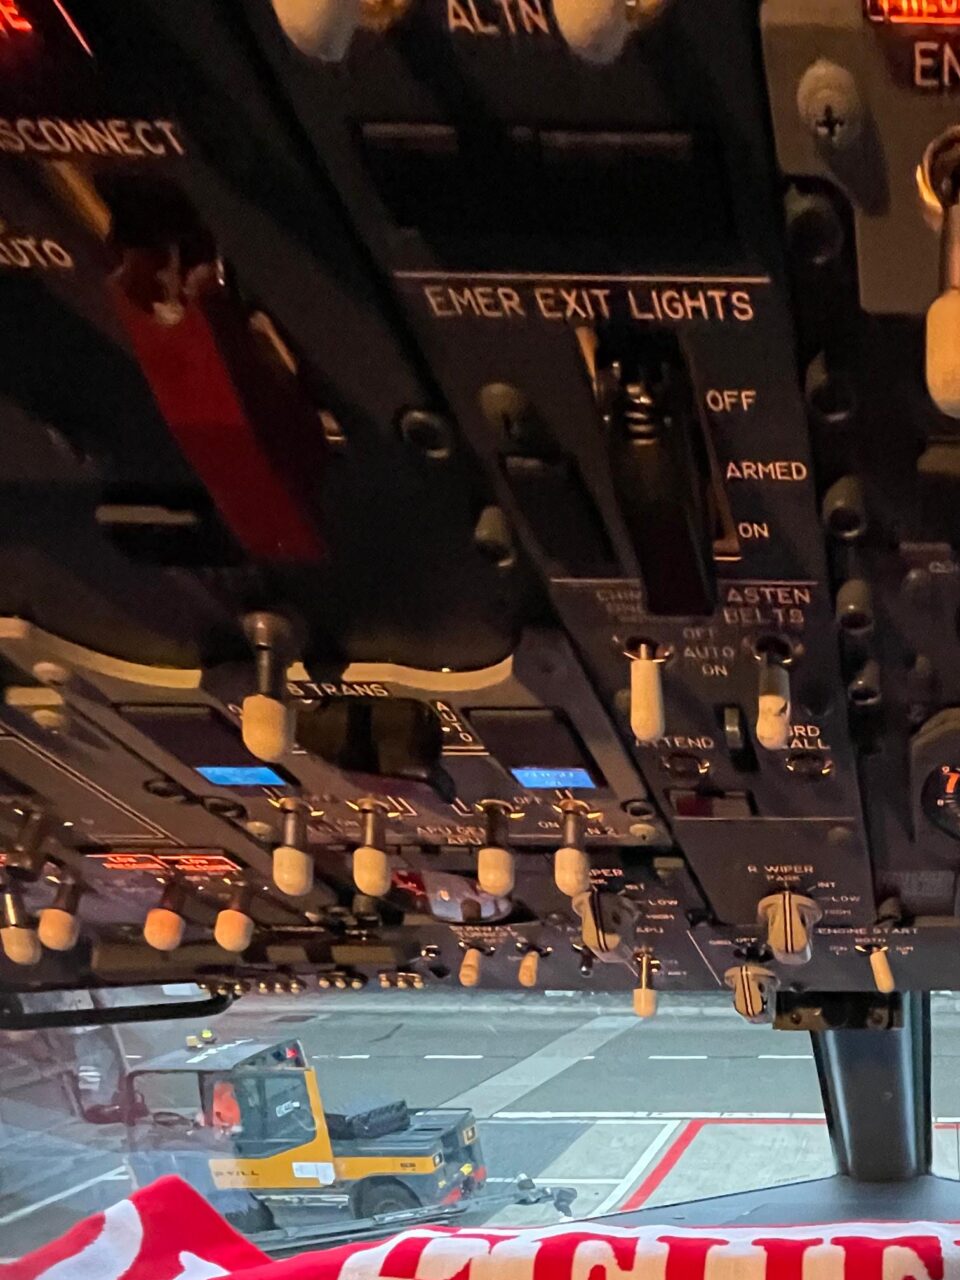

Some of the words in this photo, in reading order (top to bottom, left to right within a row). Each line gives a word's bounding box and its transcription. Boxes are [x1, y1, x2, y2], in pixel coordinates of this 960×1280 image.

[423, 286, 525, 318] EMER
[535, 288, 611, 320] EXIT
[628, 291, 754, 321] LIGHTS
[707, 389, 757, 412] OFF
[726, 461, 807, 481] ARMED
[738, 522, 770, 540] ON
[728, 588, 811, 605] ASTEN
[310, 683, 389, 697] TRANS
[764, 865, 814, 874] WIPER
[817, 927, 867, 935] ENGINE
[872, 927, 918, 935] START
